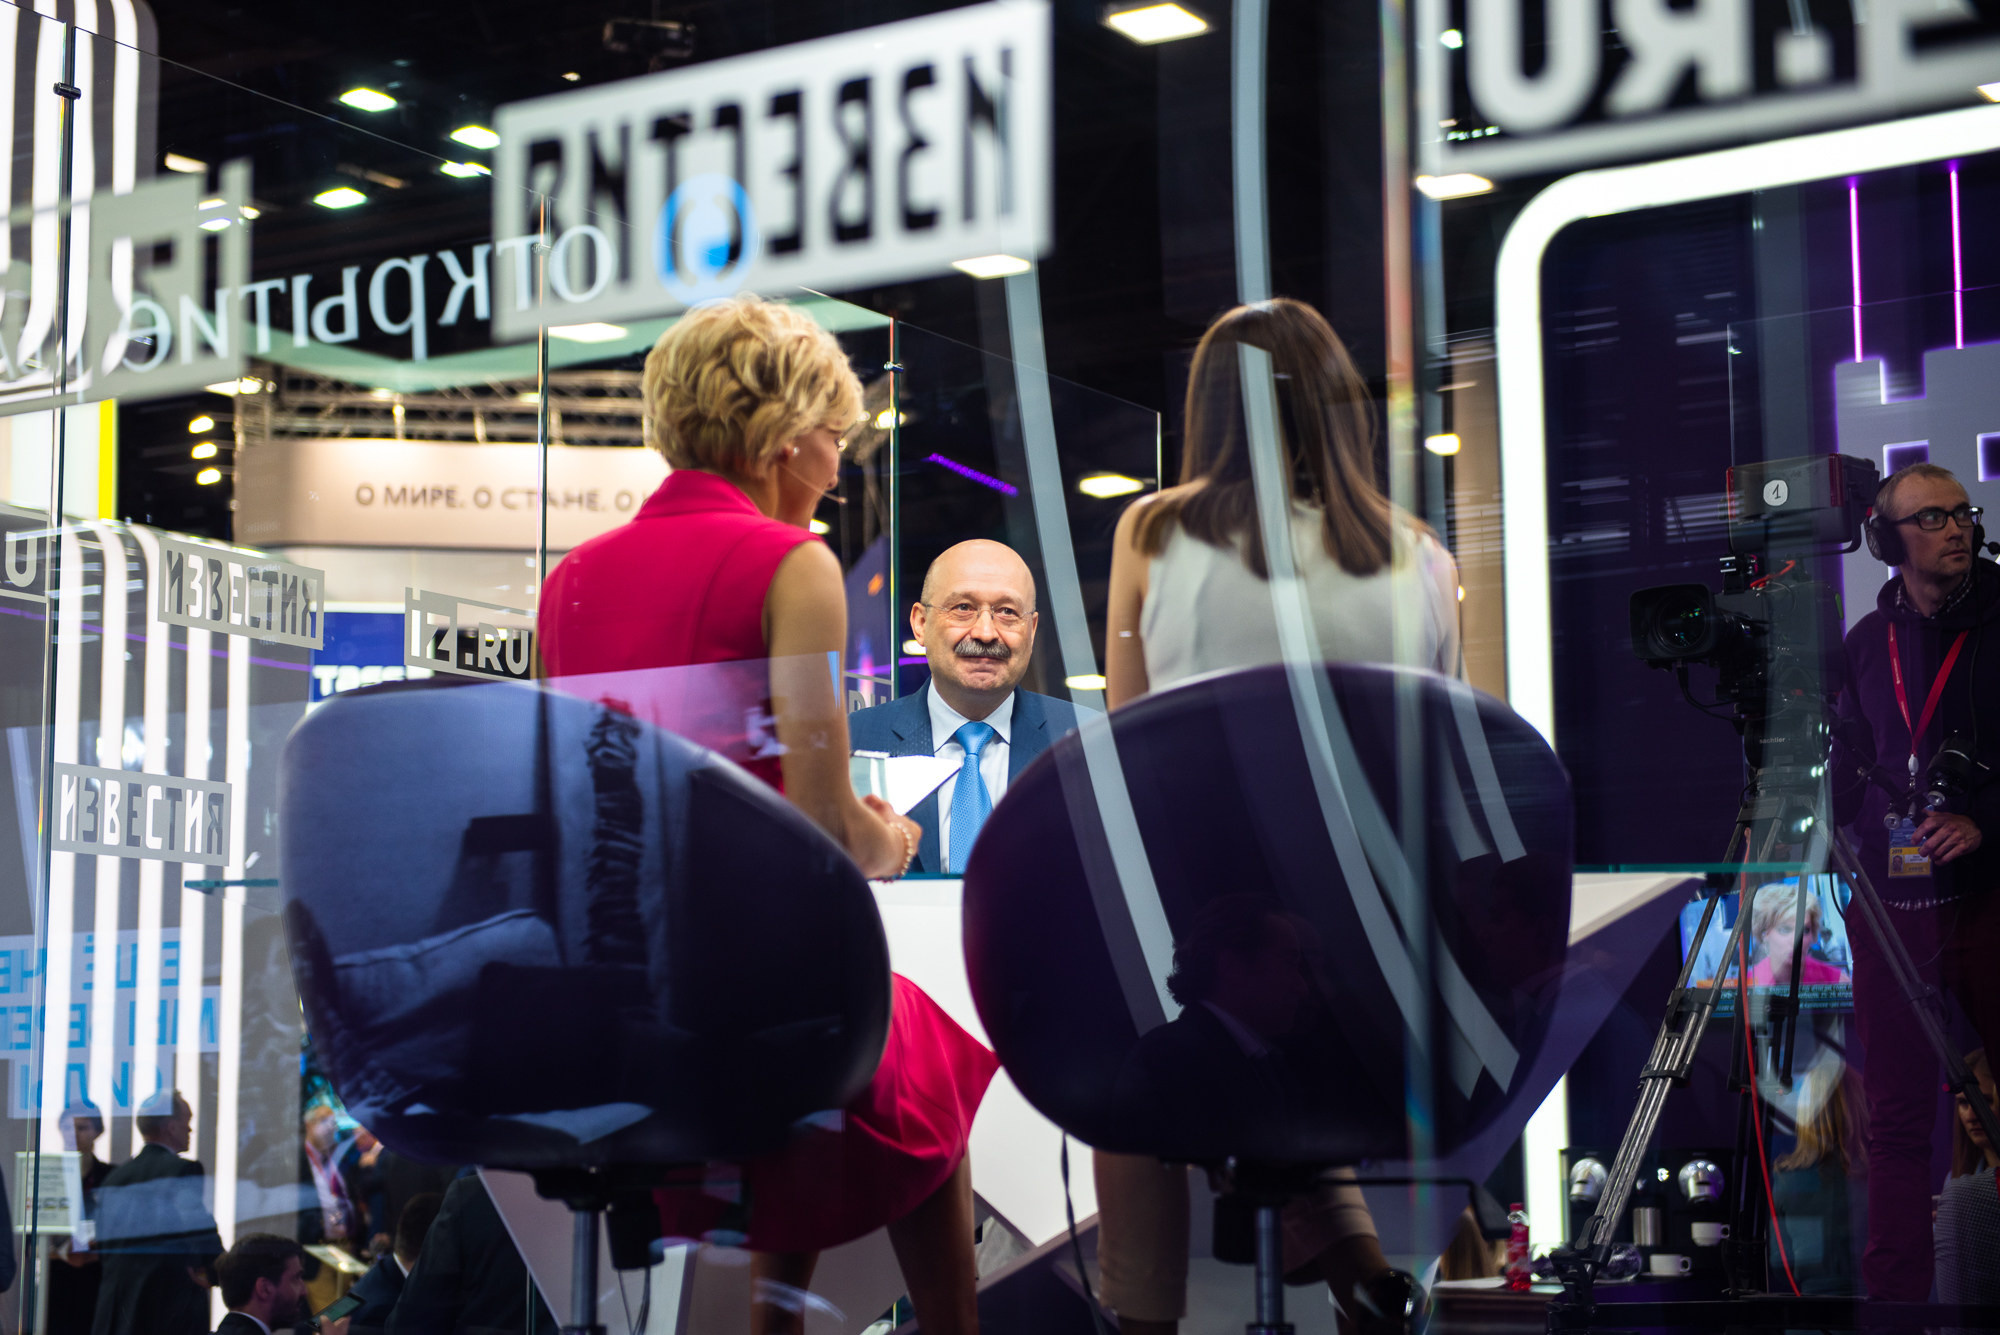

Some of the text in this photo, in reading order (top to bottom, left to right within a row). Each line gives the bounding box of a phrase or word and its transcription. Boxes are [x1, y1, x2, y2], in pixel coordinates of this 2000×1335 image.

[501, 487, 610, 512] СТАНЕ.
[1772, 484, 1781, 500] 1
[164, 549, 318, 640] ИЗВЕСТИЯ
[410, 608, 529, 675] IZ.RU
[59, 773, 225, 856] ИЗВЕСТИЯ
